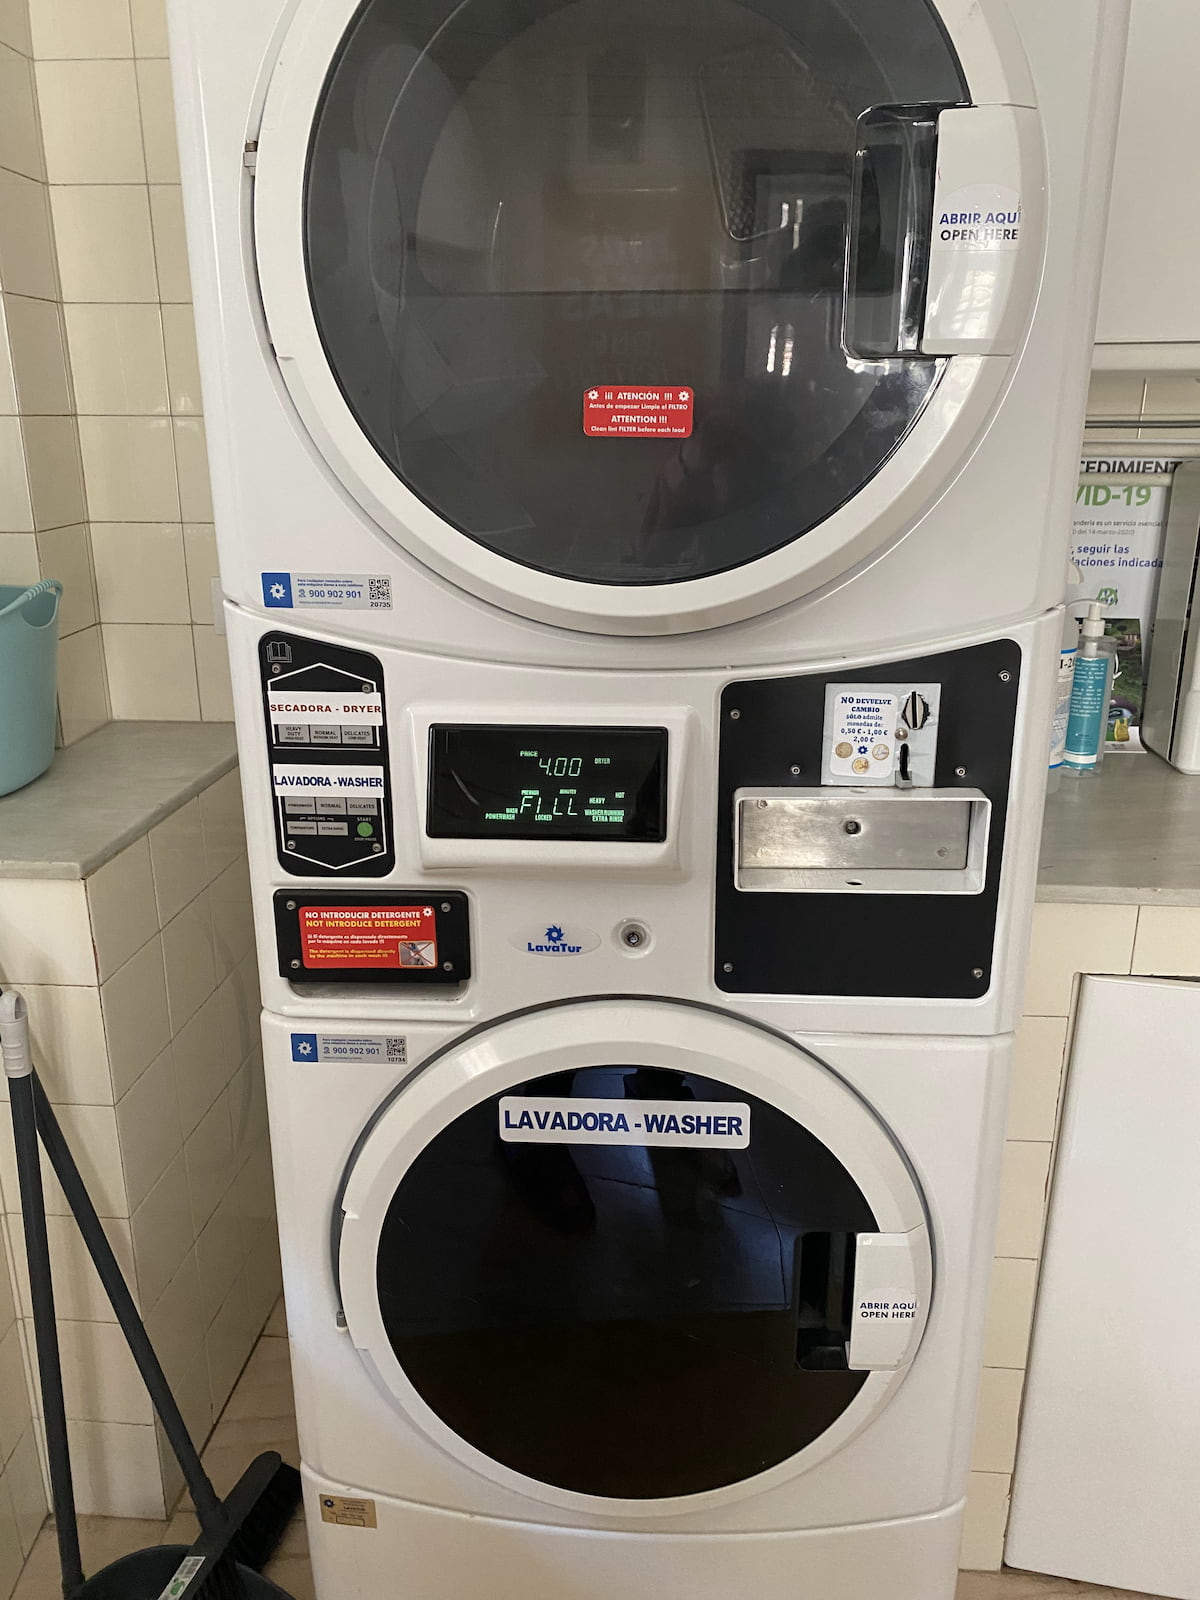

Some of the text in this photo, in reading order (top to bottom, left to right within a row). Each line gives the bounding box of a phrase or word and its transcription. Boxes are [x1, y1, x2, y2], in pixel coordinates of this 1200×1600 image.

[940, 212, 980, 225] ABRIR
[941, 229, 1018, 241] OPEN HERE
[617, 391, 660, 401] ATENCIÓN
[611, 416, 668, 424] ATTENTION !!!
[1077, 544, 1110, 556] seguir
[1114, 544, 1129, 554] las
[309, 589, 361, 599] 900 902 901
[841, 696, 854, 704] NO
[270, 704, 333, 713] SECADORA
[344, 705, 382, 713] DRYER
[594, 757, 611, 765] DRYER
[539, 758, 583, 777] 4.00
[274, 775, 332, 787] LAVADORA
[519, 796, 578, 815] FILL
[588, 797, 605, 805] HEAVY
[485, 813, 515, 821] POWERWASH
[304, 911, 319, 919] NO
[371, 912, 421, 920] DETERGENTE
[325, 920, 373, 928] INTRODUCE
[374, 920, 422, 928] DETERGENT
[527, 942, 582, 953] LavaTur
[332, 1046, 348, 1055] 900
[349, 1047, 364, 1056] 902
[504, 1109, 629, 1133] LAVADORA
[860, 1302, 889, 1310] ABRIR
[860, 1311, 917, 1319] OPEN HERE
